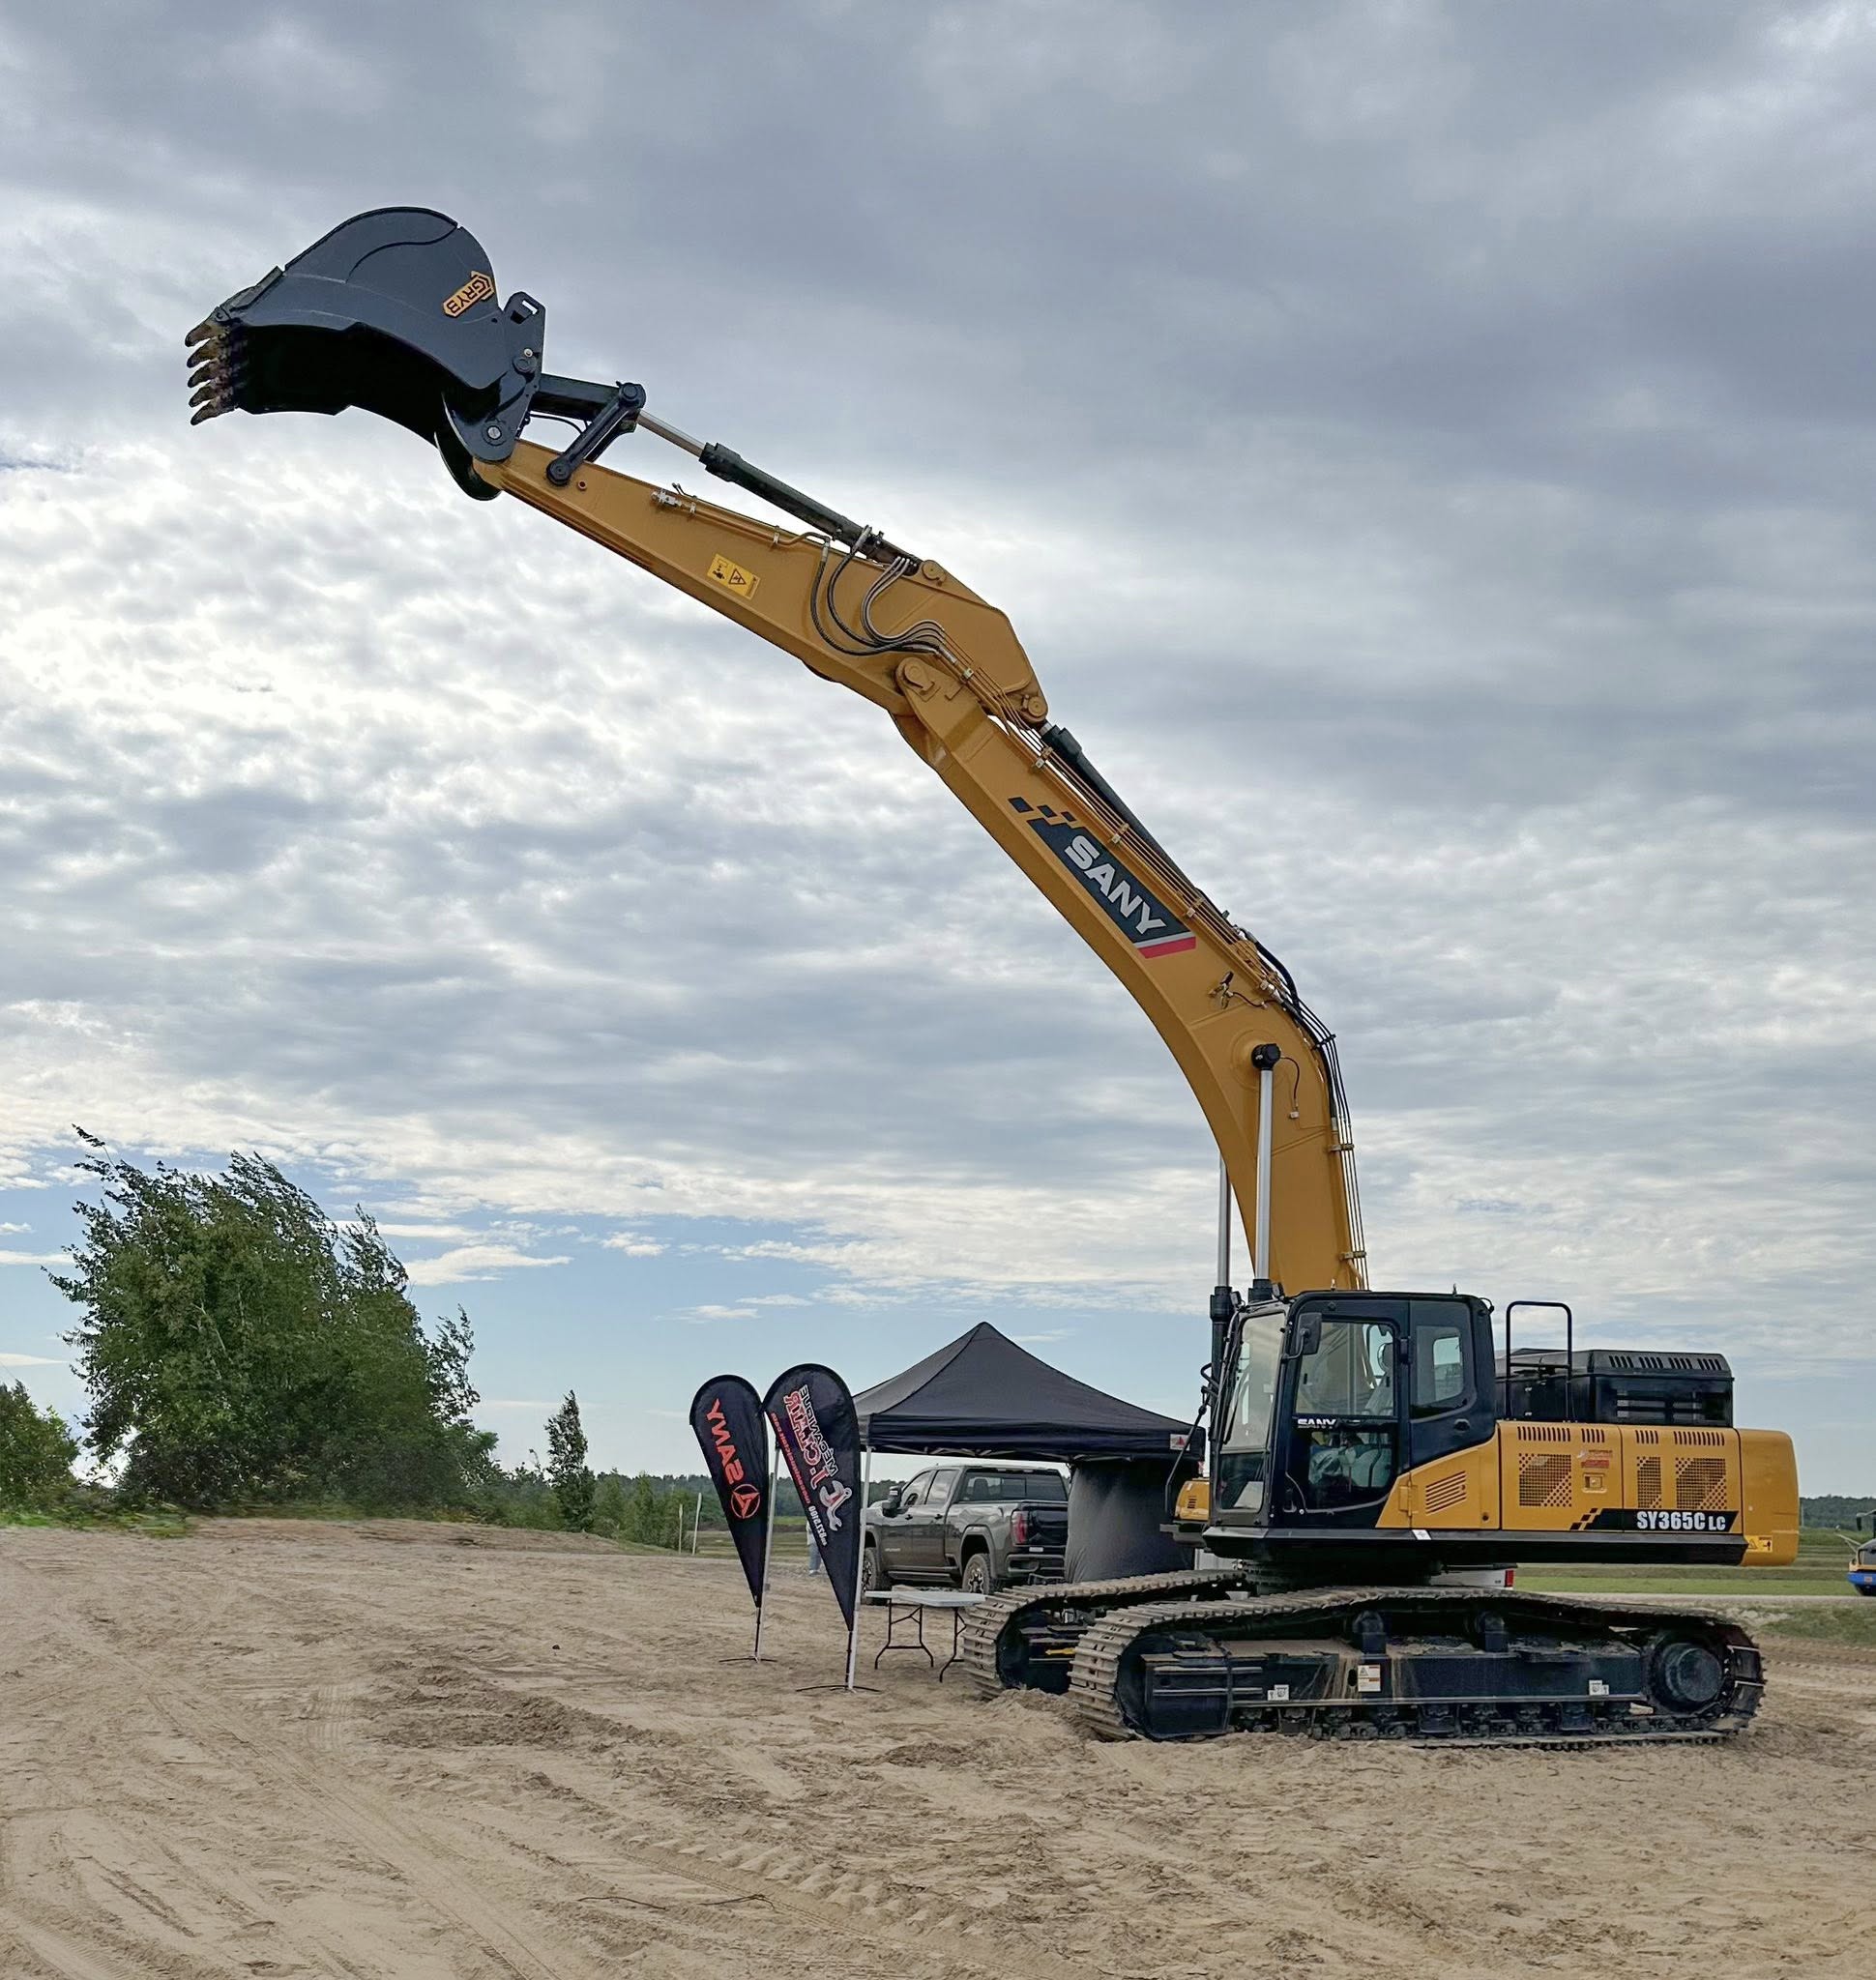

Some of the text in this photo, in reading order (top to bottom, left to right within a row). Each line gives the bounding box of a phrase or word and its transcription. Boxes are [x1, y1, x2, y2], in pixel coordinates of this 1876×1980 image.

[446, 278, 487, 314] GRYB
[1064, 834, 1166, 935] SANY
[1636, 1510, 1726, 1530] SY365C LC
